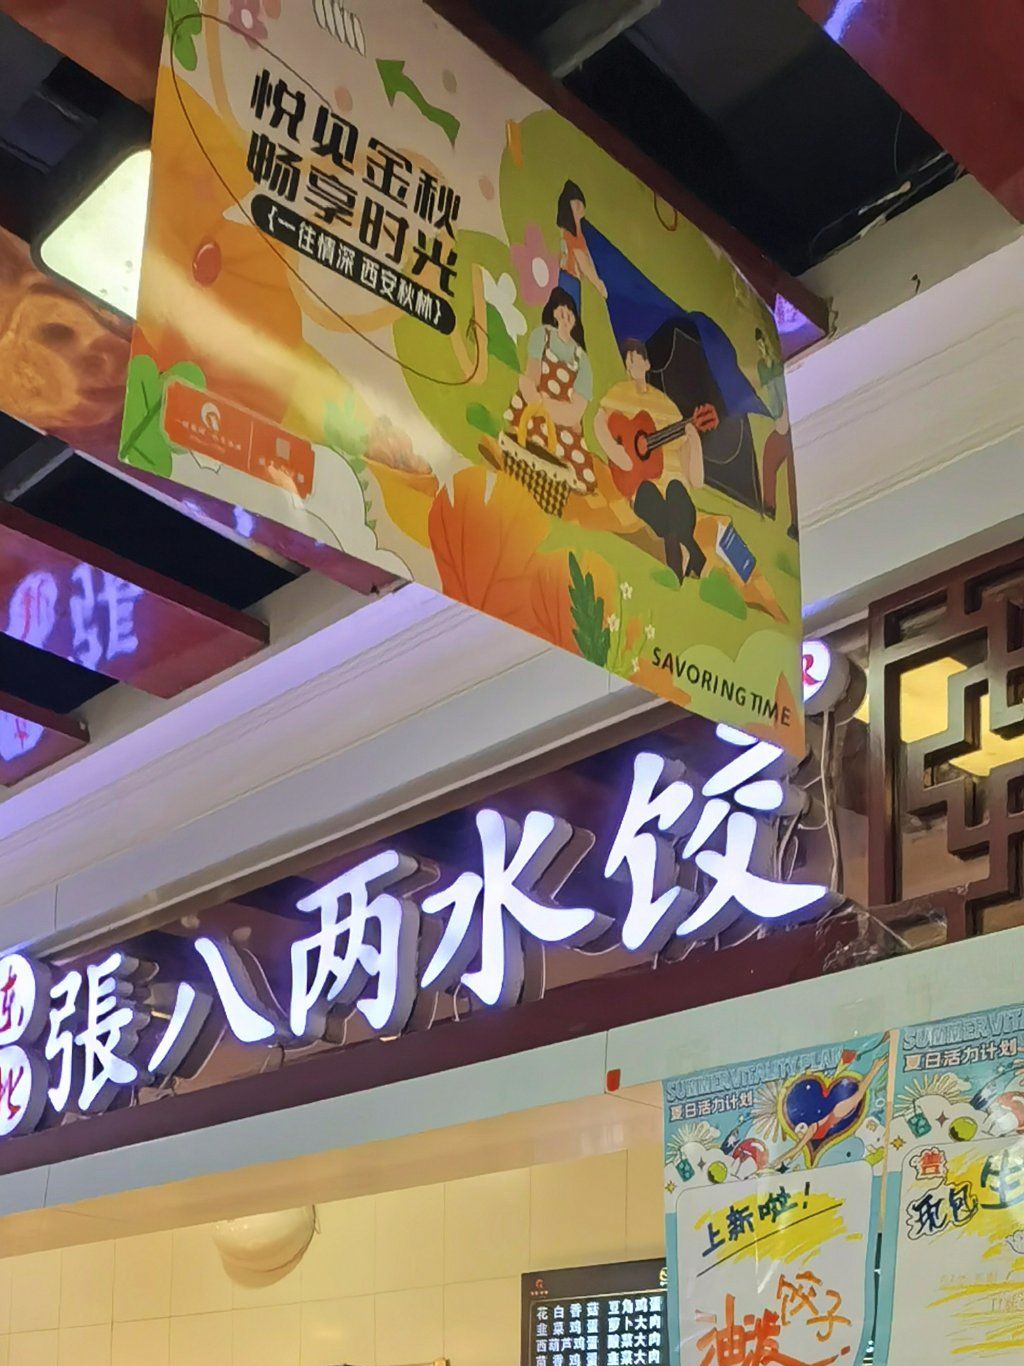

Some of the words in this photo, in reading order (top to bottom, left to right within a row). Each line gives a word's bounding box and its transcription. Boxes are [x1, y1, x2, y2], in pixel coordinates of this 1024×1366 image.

[250, 69, 462, 241] 悦见金秋
[246, 130, 458, 297] 畅享时光
[652, 647, 746, 708] SAVORING
[750, 691, 792, 727] TIME
[45, 722, 828, 1113] 張八两水饺
[904, 1037, 1018, 1073] 夏日活力计划
[669, 1090, 755, 1122] 夏日活力计划
[608, 1296, 663, 1315] 豆角鸡蛋
[608, 1314, 662, 1333] 萝卜大肉
[536, 1335, 599, 1352] 西葫芦鸡蛋
